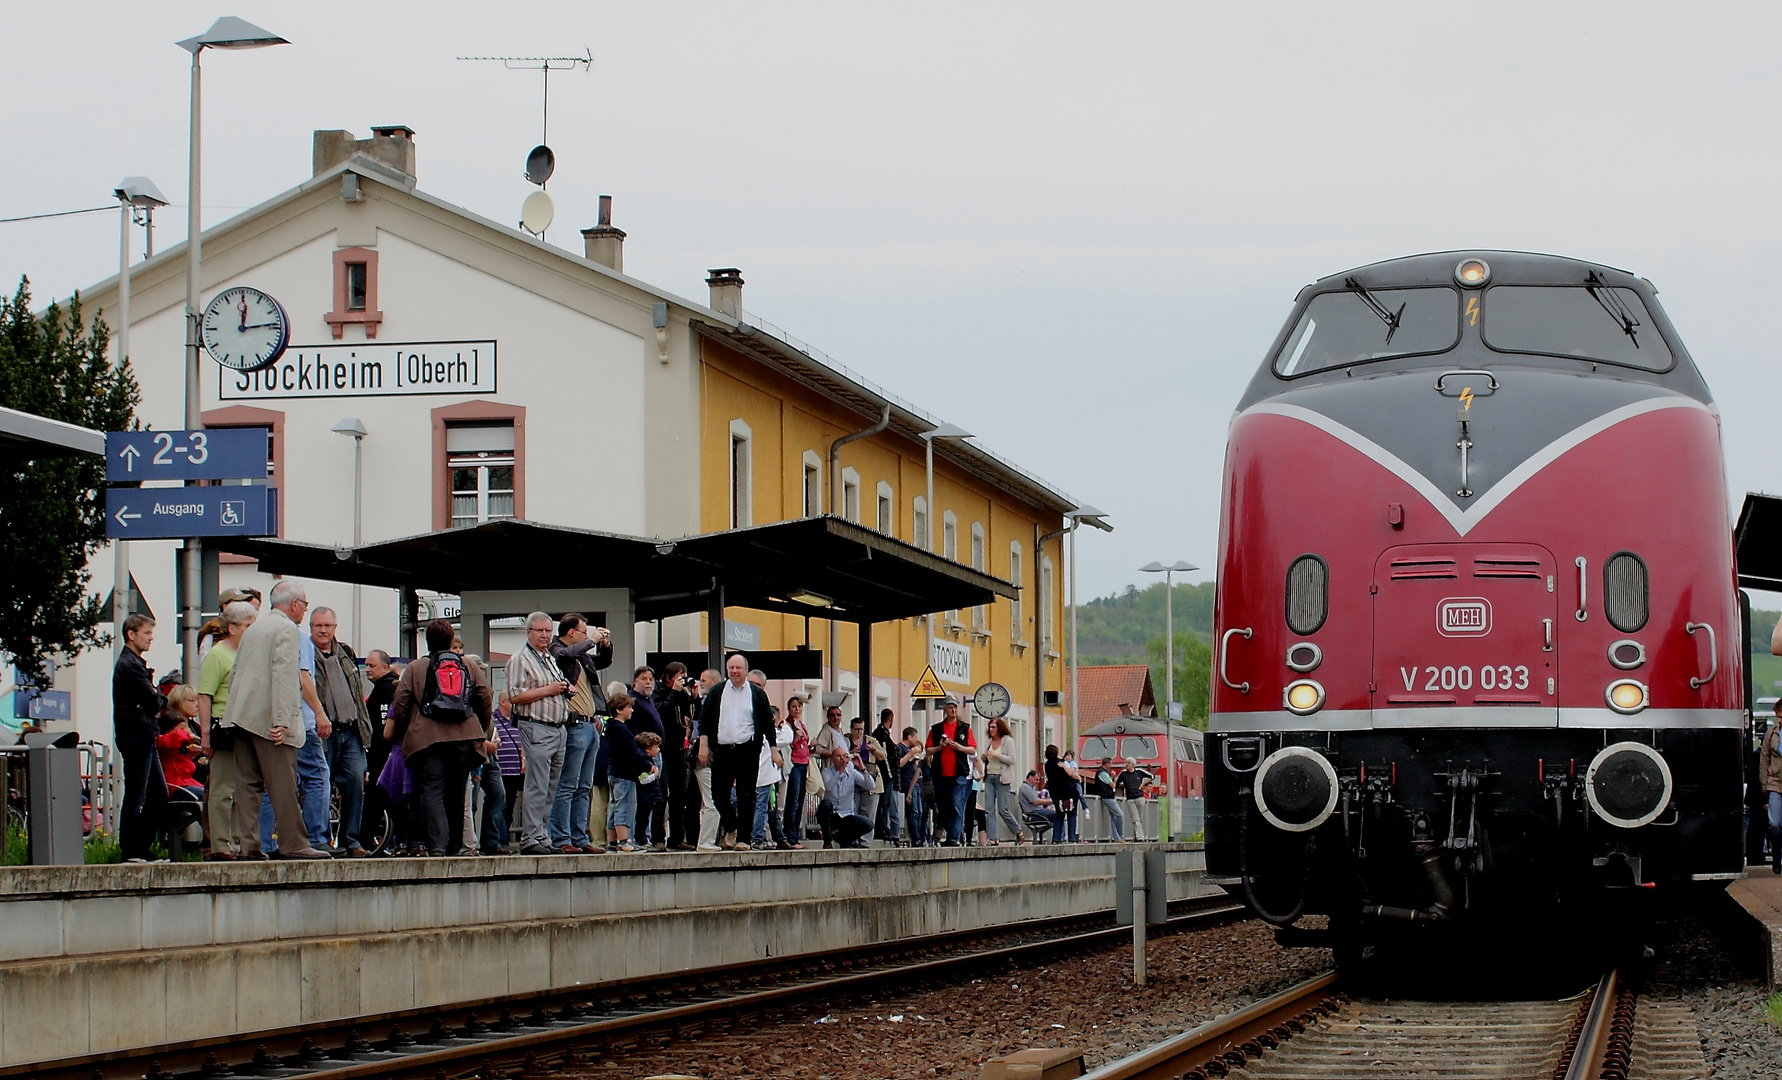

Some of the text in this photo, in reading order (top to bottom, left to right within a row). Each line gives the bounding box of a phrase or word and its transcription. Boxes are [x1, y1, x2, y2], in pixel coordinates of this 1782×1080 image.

[235, 350, 478, 391] Stockheim [Oberh]
[153, 432, 208, 465] 2-3
[153, 502, 204, 517] Ausgang
[1448, 608, 1481, 626] MEH
[1400, 665, 1529, 692] V 200 033
